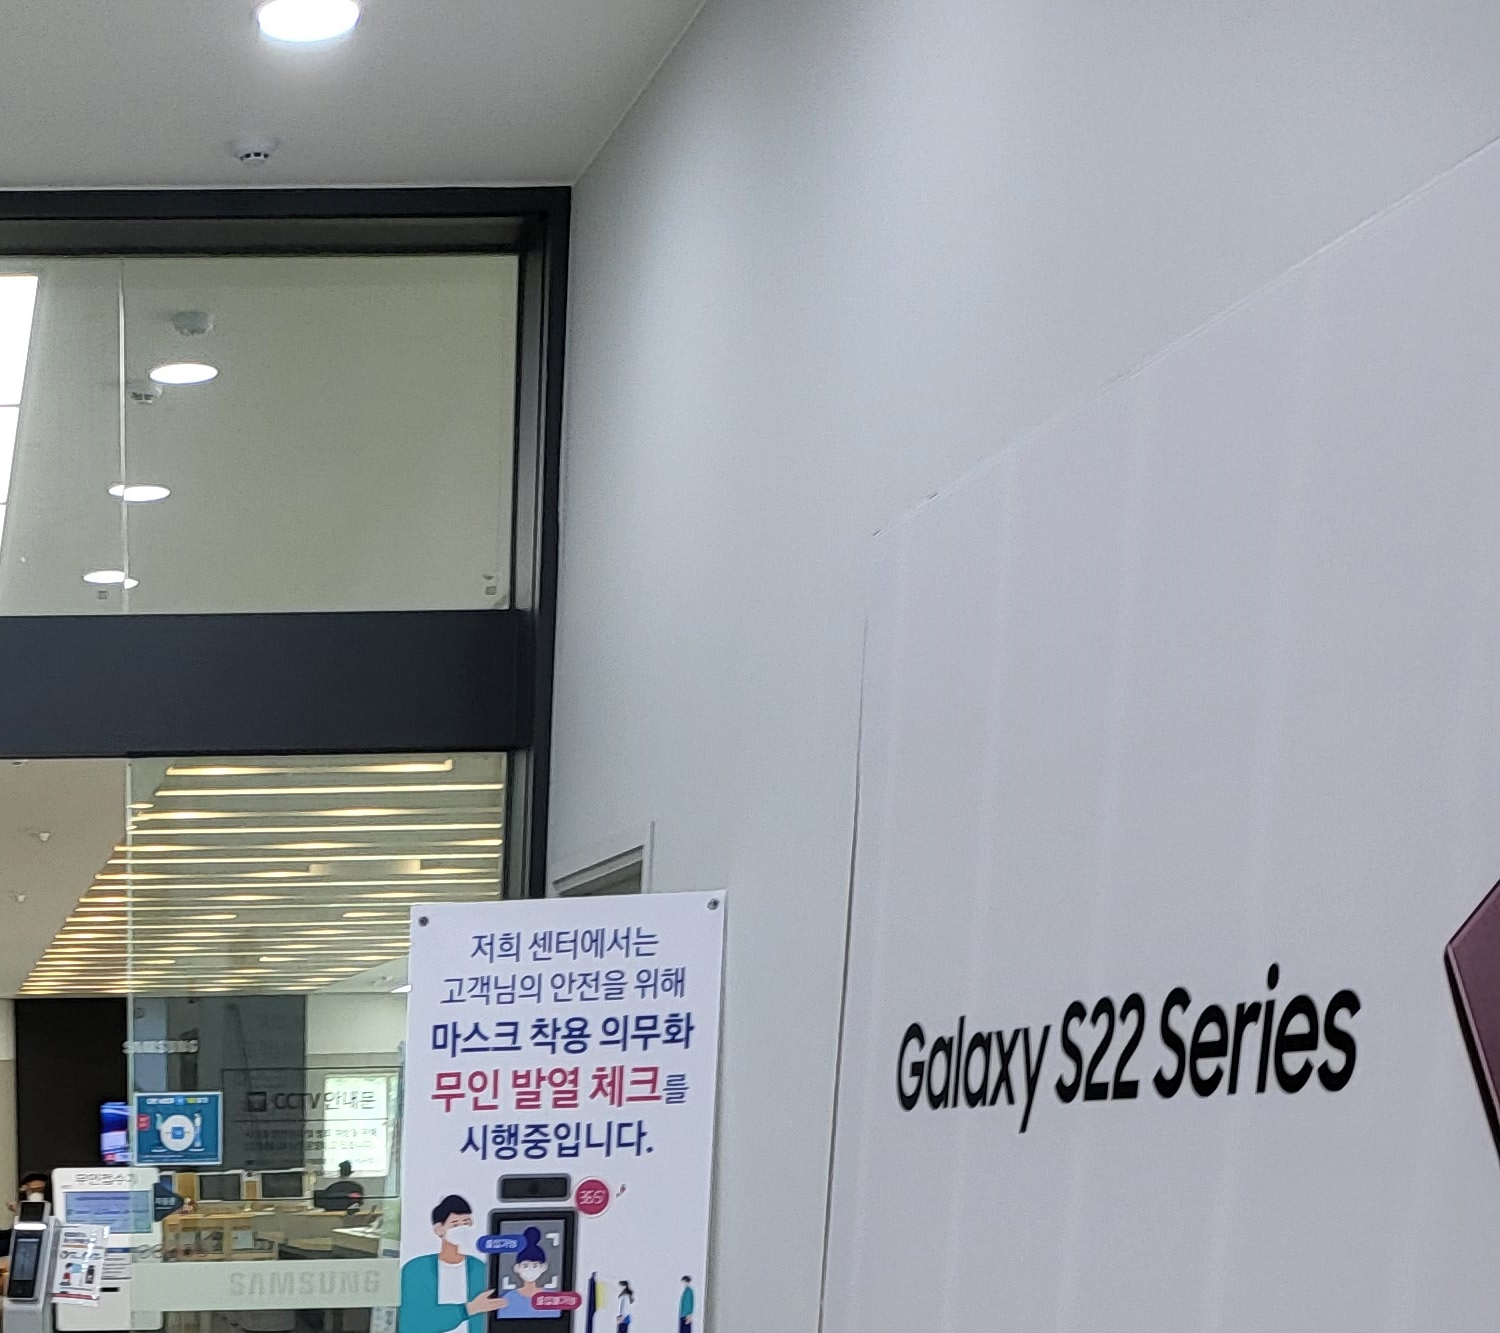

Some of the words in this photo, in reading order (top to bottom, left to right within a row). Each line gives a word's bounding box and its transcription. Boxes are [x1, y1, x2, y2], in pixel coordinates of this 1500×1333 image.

[470, 932, 521, 964] 저희
[528, 926, 660, 962] 센터에서는
[439, 972, 543, 1007] 고객님의
[550, 970, 628, 1003] 안전을
[634, 966, 686, 1000] 위해
[431, 1021, 523, 1058] 마스크
[529, 1016, 592, 1055] 착용
[599, 1012, 695, 1051] 의무화
[897, 1015, 1051, 1134] Galaxy
[1054, 992, 1146, 1103] S22
[1152, 961, 1361, 1100] Series
[272, 1092, 322, 1110] CCTV
[430, 1068, 500, 1113] 무인
[512, 1065, 580, 1111] 발열
[589, 1064, 690, 1107] 체크를
[460, 1120, 655, 1160] 시행중입니다.
[229, 1270, 381, 1297] SAMSUNG
